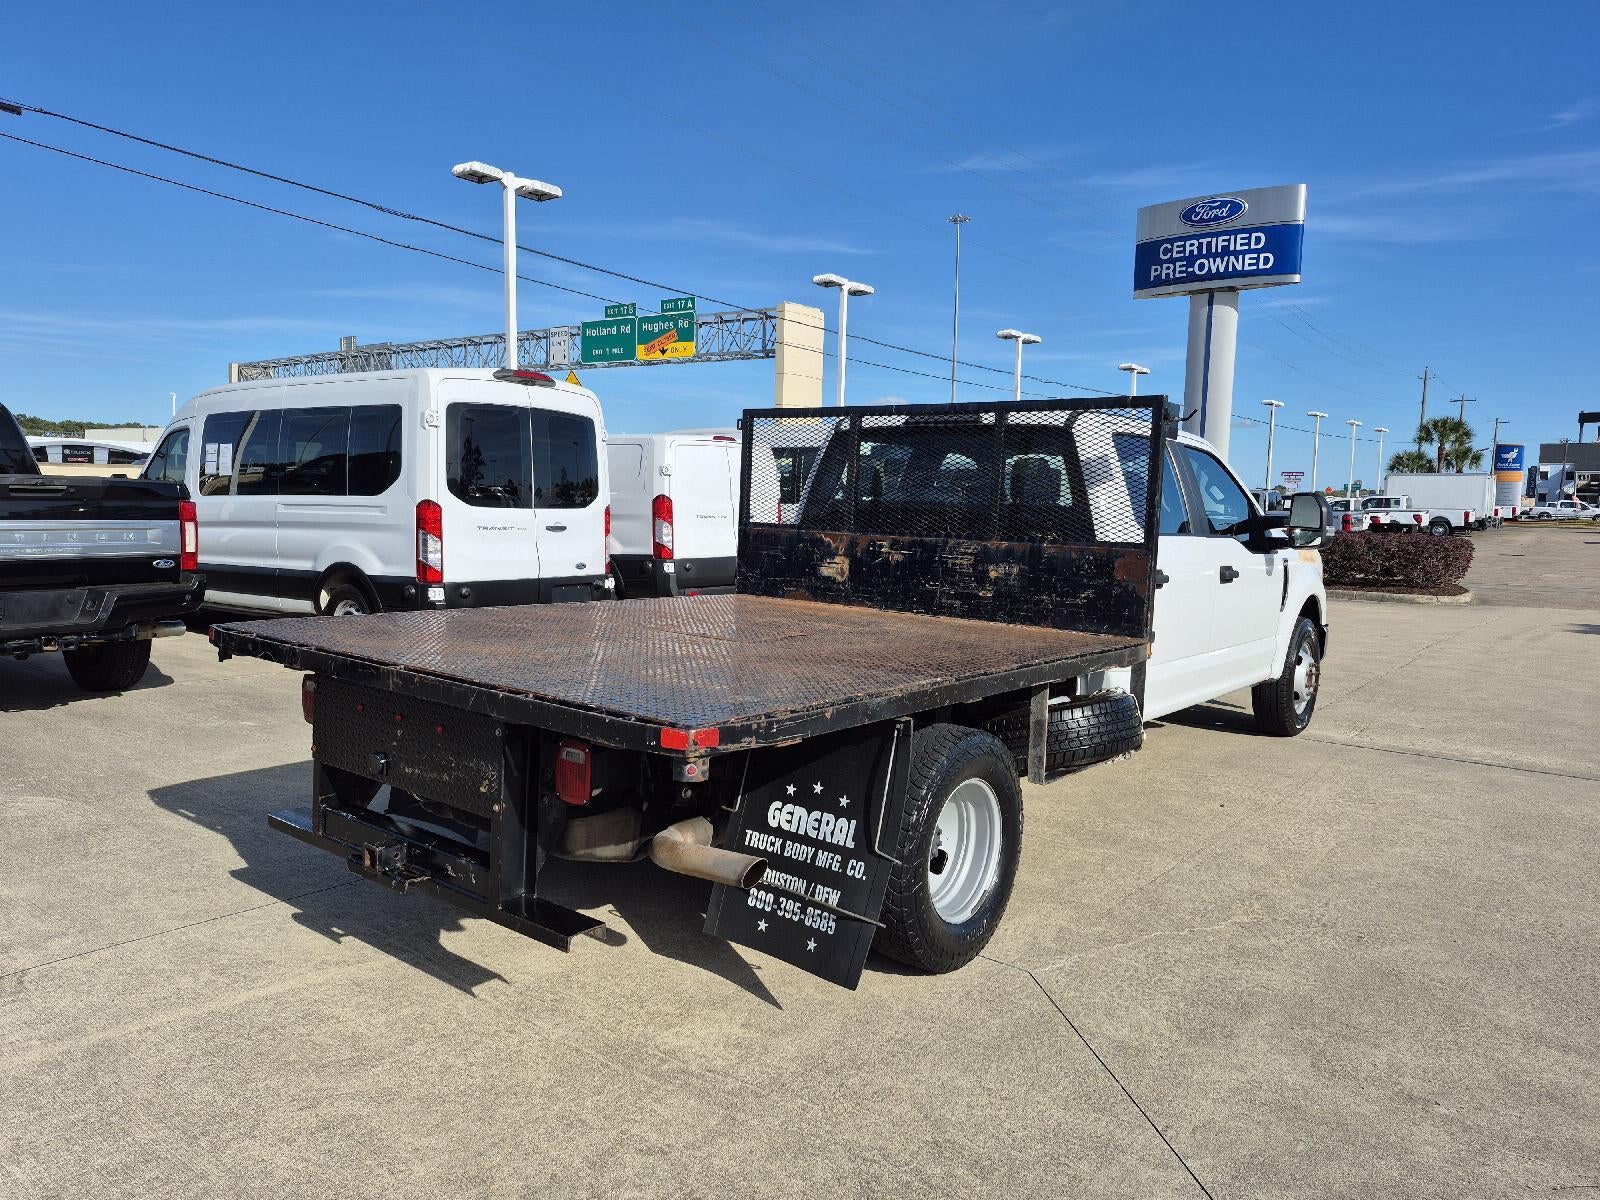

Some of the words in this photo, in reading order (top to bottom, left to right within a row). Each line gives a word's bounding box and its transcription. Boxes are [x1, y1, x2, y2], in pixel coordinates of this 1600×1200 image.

[1191, 200, 1230, 221] Ford
[1159, 232, 1266, 260] CERTIFIED
[1150, 252, 1275, 282] PRE-OWNED
[663, 302, 675, 310] EXIT
[677, 300, 686, 309] 17
[586, 325, 617, 337] Holland
[620, 323, 631, 334] Rd
[642, 320, 674, 333] Hughes
[678, 318, 689, 329] Rd
[767, 800, 857, 849] GENERAL
[744, 829, 783, 855] TRUCK
[783, 840, 815, 864] BODY
[815, 849, 843, 873] MFG.
[846, 859, 867, 881] CO.
[763, 868, 807, 895] OUSTON
[814, 884, 842, 908] DFW
[747, 887, 837, 935] 800-395-8585
